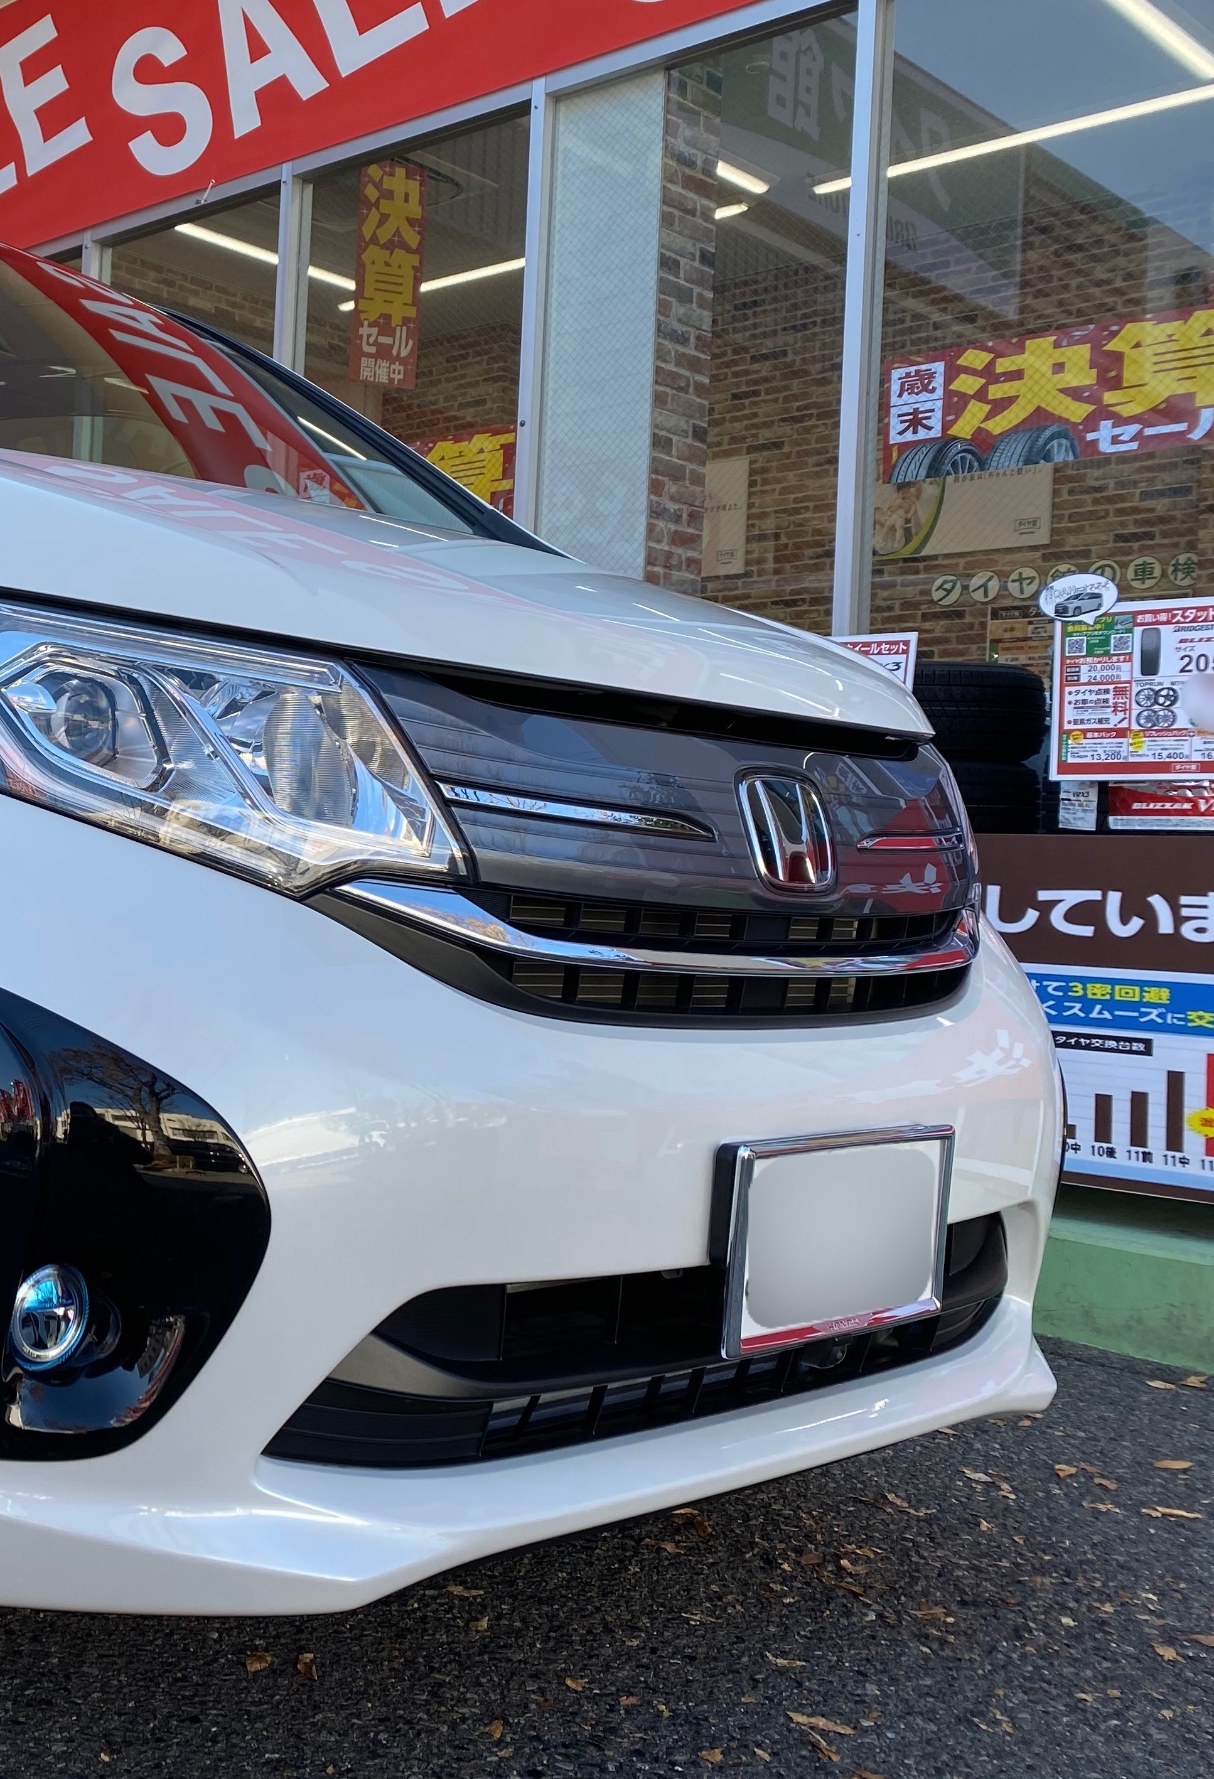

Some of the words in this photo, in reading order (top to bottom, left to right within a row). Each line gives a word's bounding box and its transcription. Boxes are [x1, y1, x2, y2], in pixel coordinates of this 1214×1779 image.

[112, 0, 480, 177] SAL
[358, 163, 423, 327] 決算
[358, 320, 414, 358] セール
[359, 357, 405, 386] 開催中
[947, 308, 1214, 440] 決算
[896, 367, 938, 437] 歳末
[1179, 653, 1214, 674] 20
[1074, 688, 1111, 696] タイヤ点検
[1054, 1035, 1147, 1052] タイヤ交換台数
[1163, 1154, 1191, 1169] 11中
